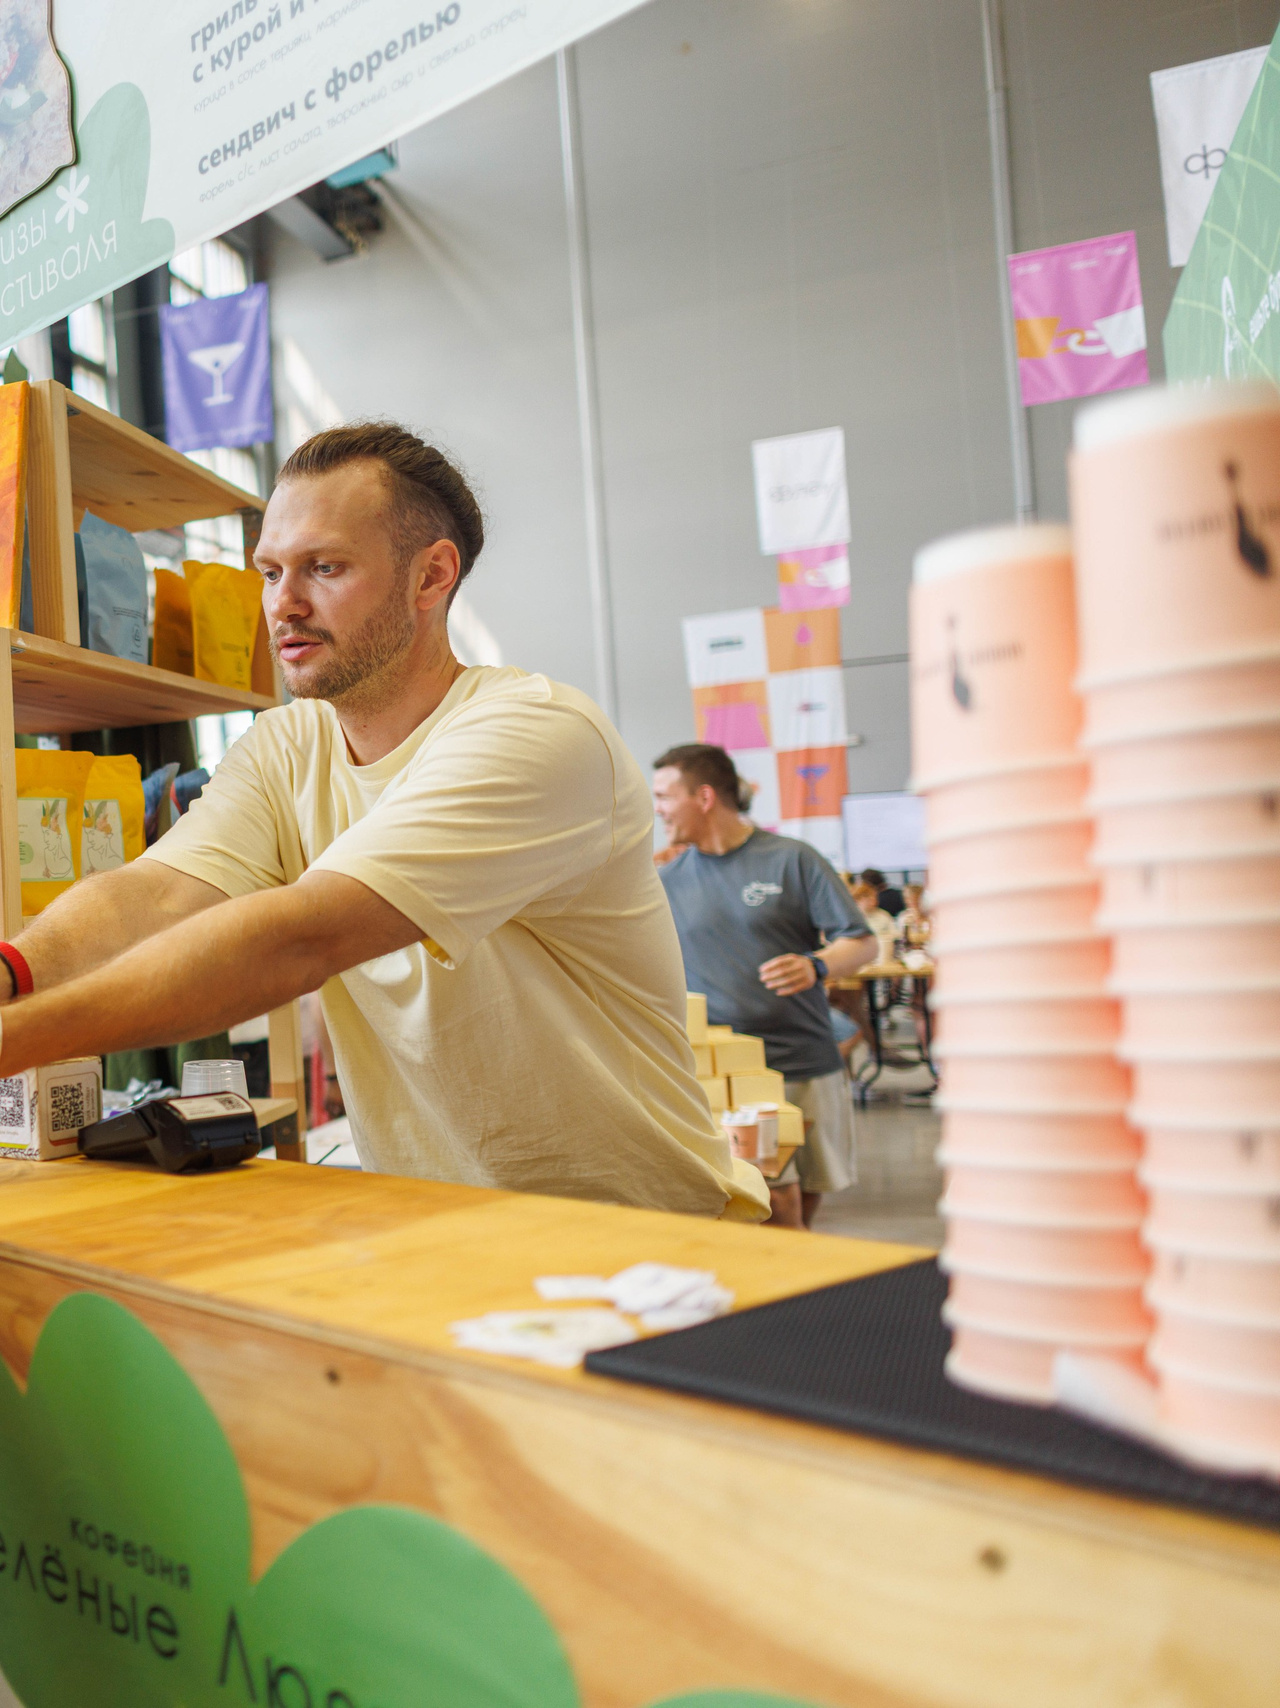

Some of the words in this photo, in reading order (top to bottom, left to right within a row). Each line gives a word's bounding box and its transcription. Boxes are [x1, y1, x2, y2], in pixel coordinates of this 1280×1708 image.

[192, 62, 204, 84] с
[210, 3, 282, 73] курой
[193, 85, 227, 114] курица
[316, 0, 370, 35] мармел
[198, 101, 296, 176] сендвич
[303, 88, 317, 111] с
[324, 1, 462, 104] форелью
